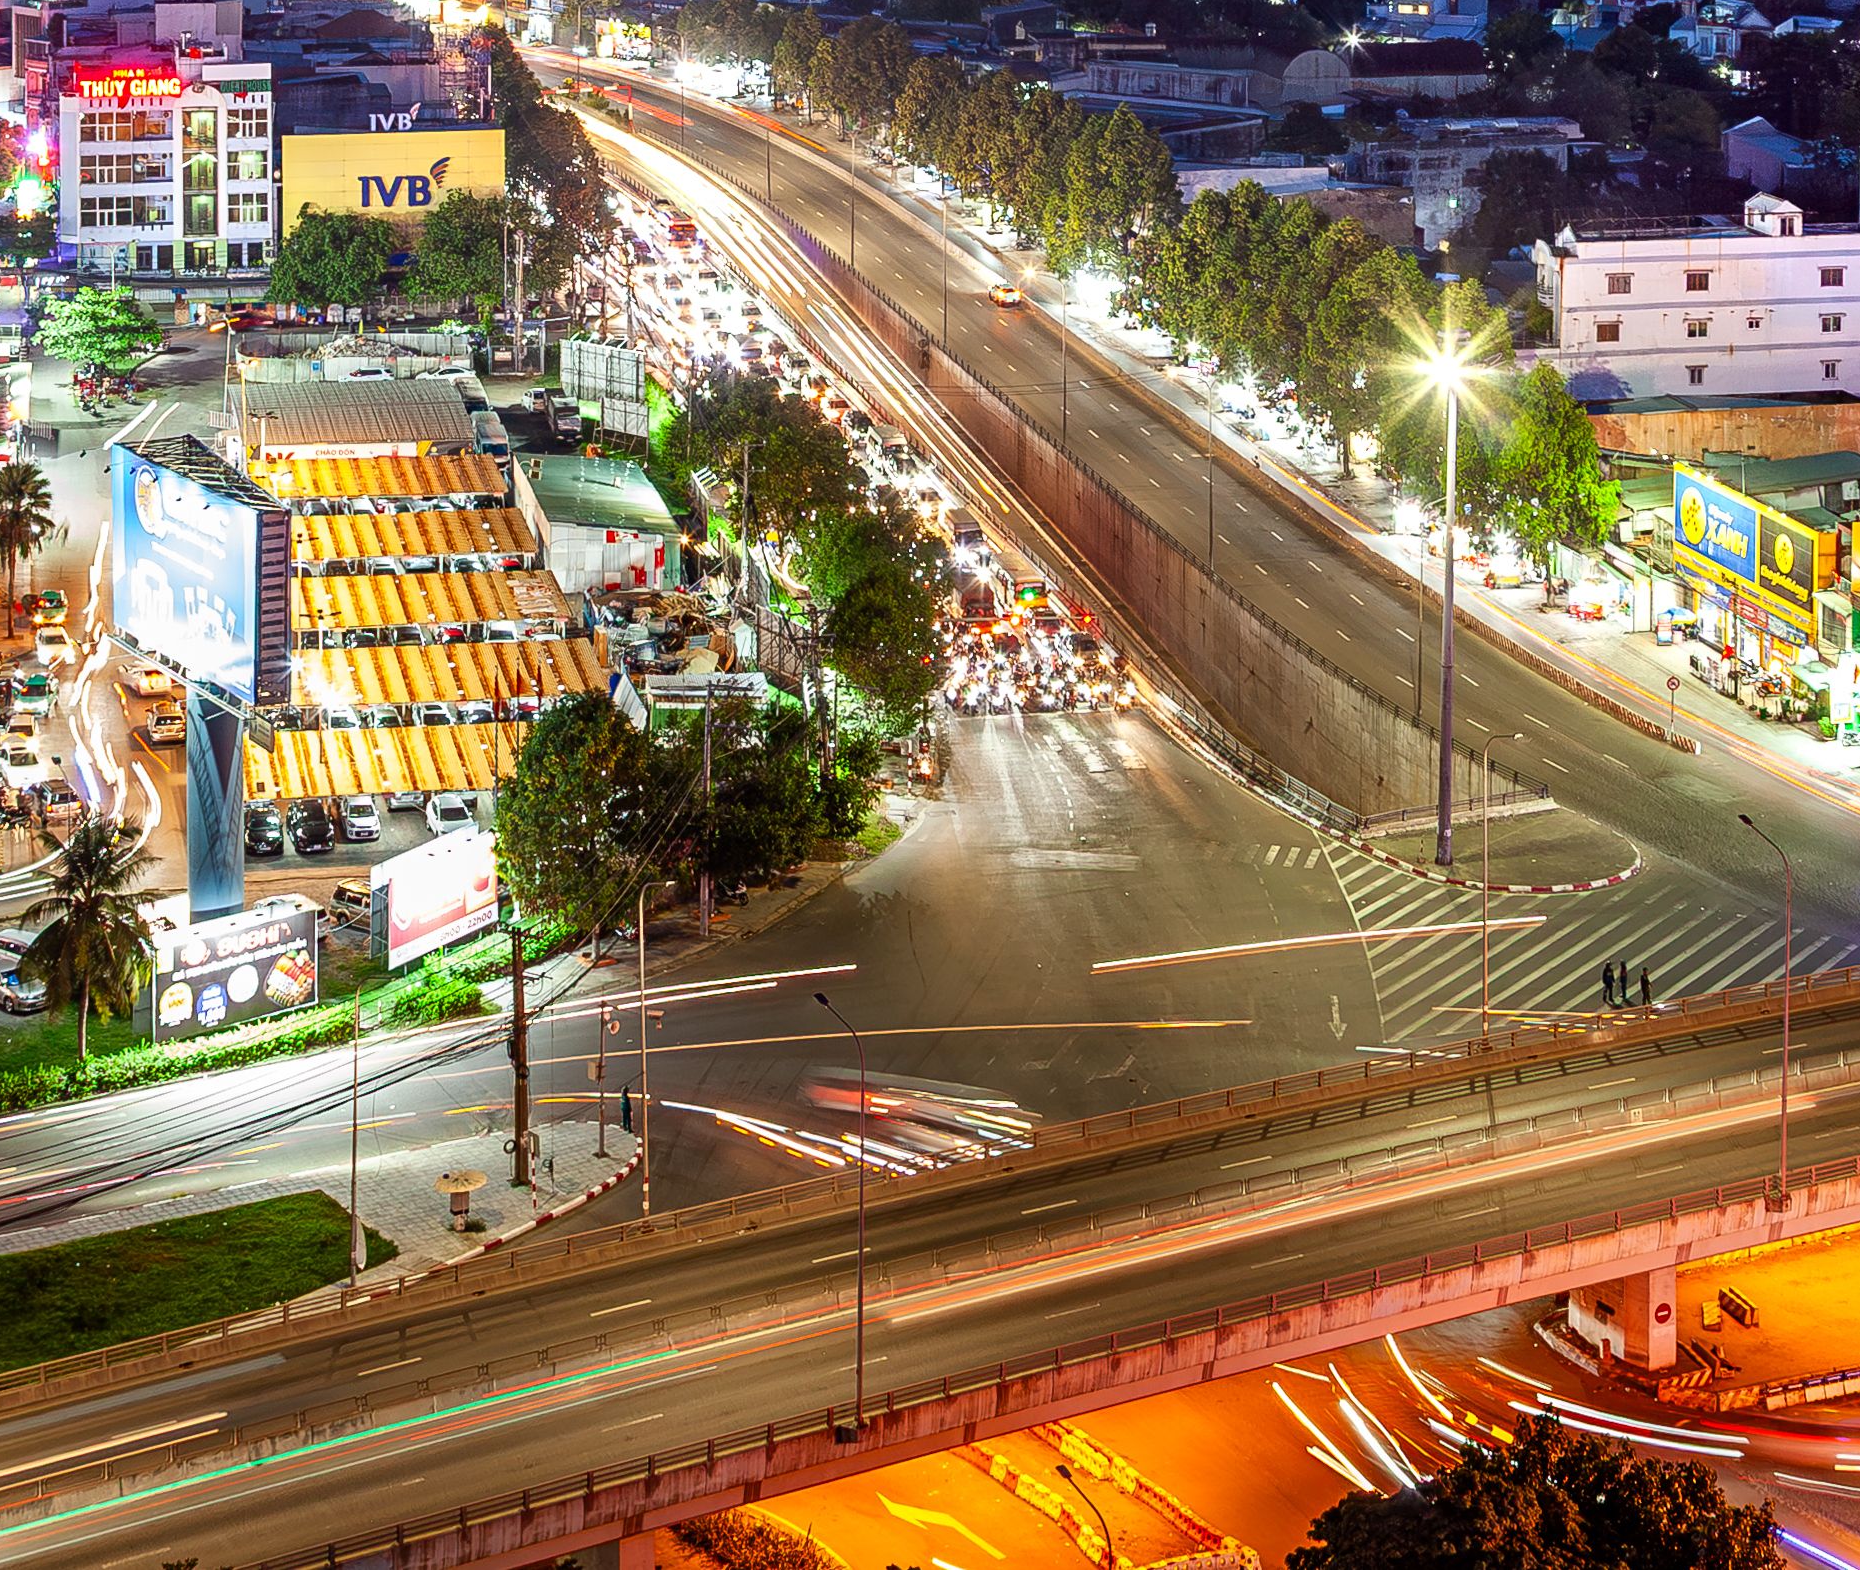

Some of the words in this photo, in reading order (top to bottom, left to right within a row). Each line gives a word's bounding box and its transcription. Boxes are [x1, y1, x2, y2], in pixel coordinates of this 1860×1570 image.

[129, 78, 181, 97] GIANG
[369, 113, 413, 132] IVB
[358, 175, 432, 208] IVB
[1705, 518, 1750, 559] XANH
